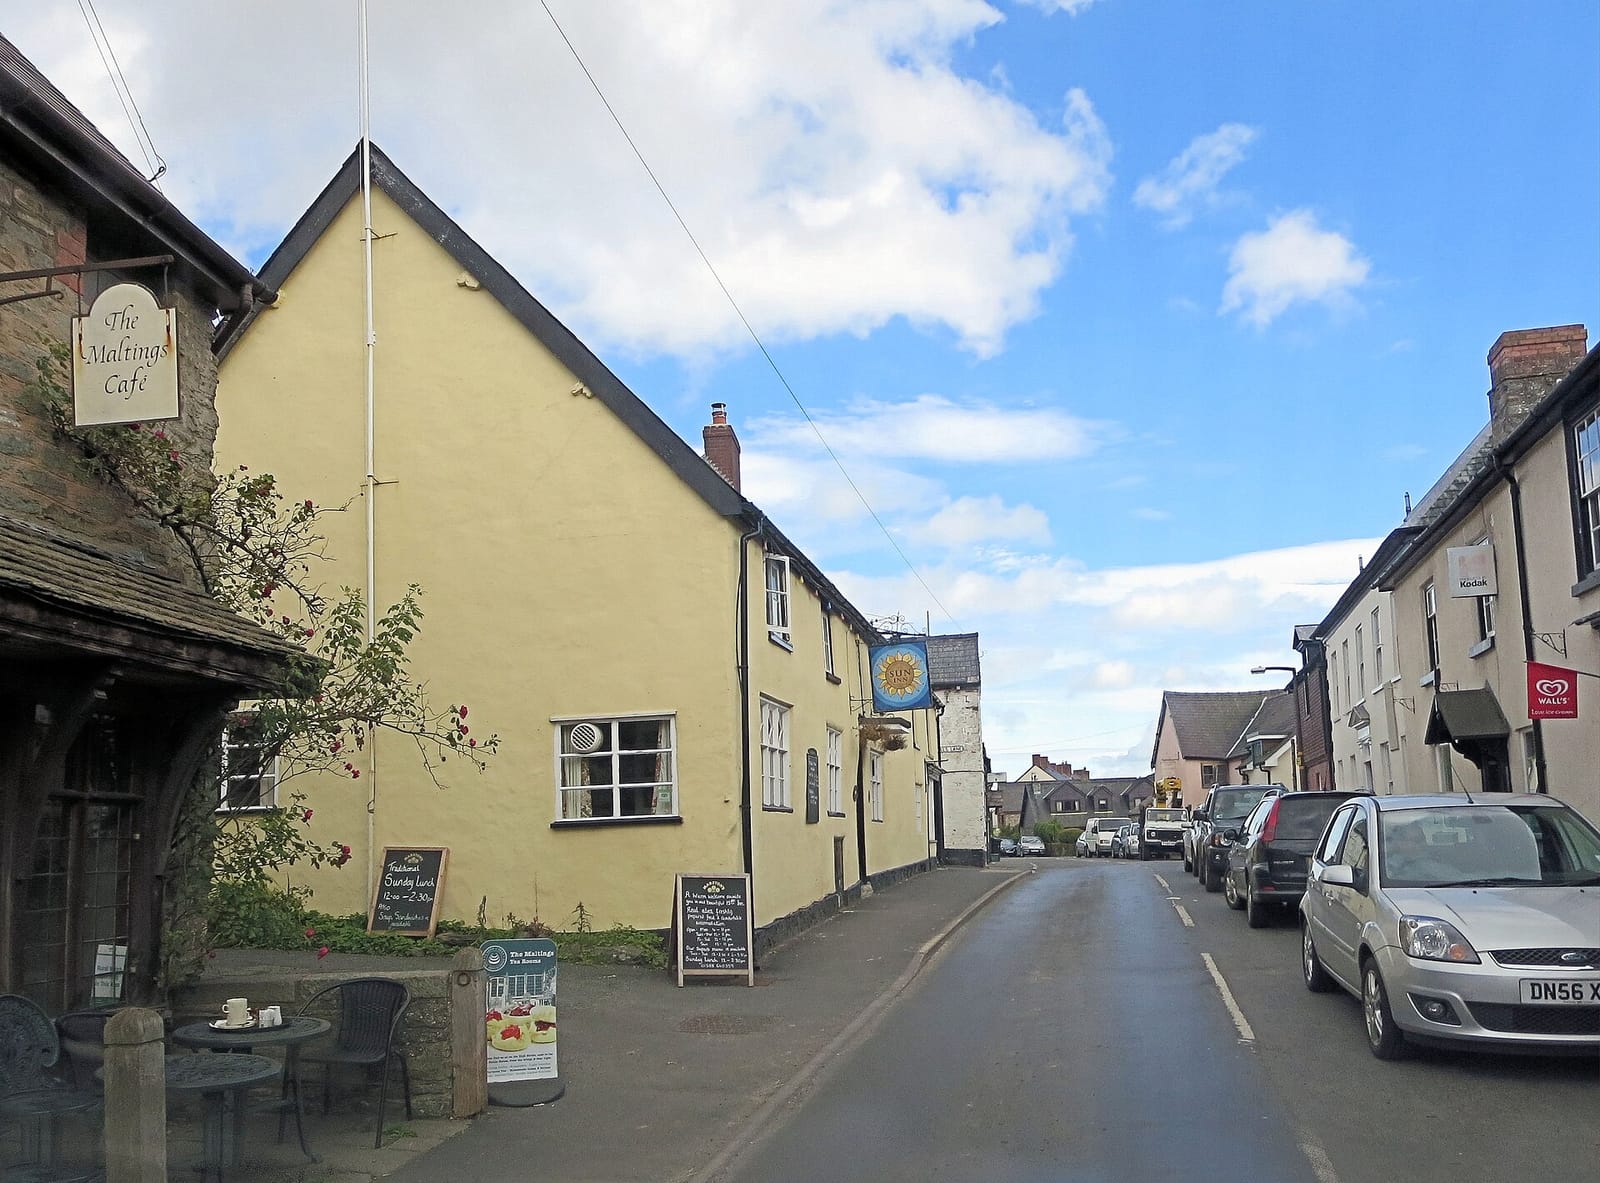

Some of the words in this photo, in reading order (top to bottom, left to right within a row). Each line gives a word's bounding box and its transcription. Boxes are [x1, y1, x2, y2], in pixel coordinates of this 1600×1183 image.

[104, 304, 139, 331] The
[82, 335, 169, 368] Maltings
[104, 366, 147, 400] Café
[1460, 579, 1487, 588] Kodak
[889, 669, 911, 677] SUN
[388, 861, 420, 872] Traditional
[384, 873, 414, 891] Sunday
[524, 950, 554, 958] Maltings
[685, 956, 702, 964] Sunday
[1530, 983, 1584, 1000] DN56
